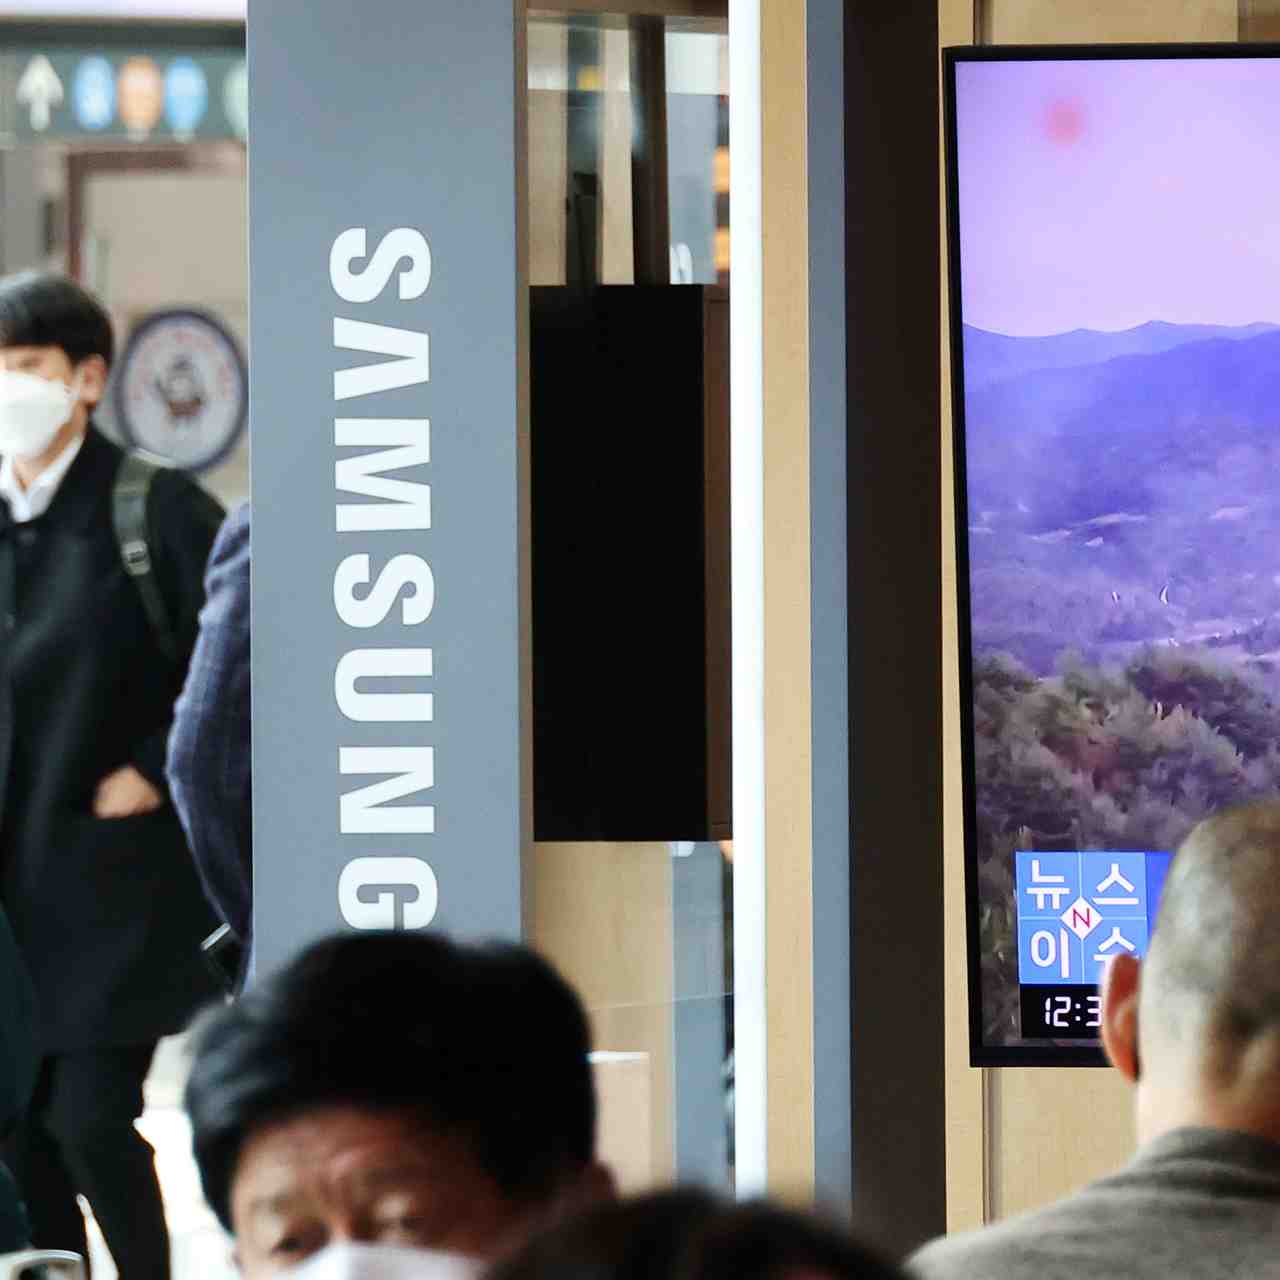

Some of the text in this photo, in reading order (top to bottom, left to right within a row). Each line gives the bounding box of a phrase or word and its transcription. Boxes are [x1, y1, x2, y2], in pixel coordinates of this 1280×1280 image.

[329, 227, 438, 931] SAMSUNG
[1026, 859, 1139, 910] 뉴스
[1045, 996, 1102, 1027] 12:3
